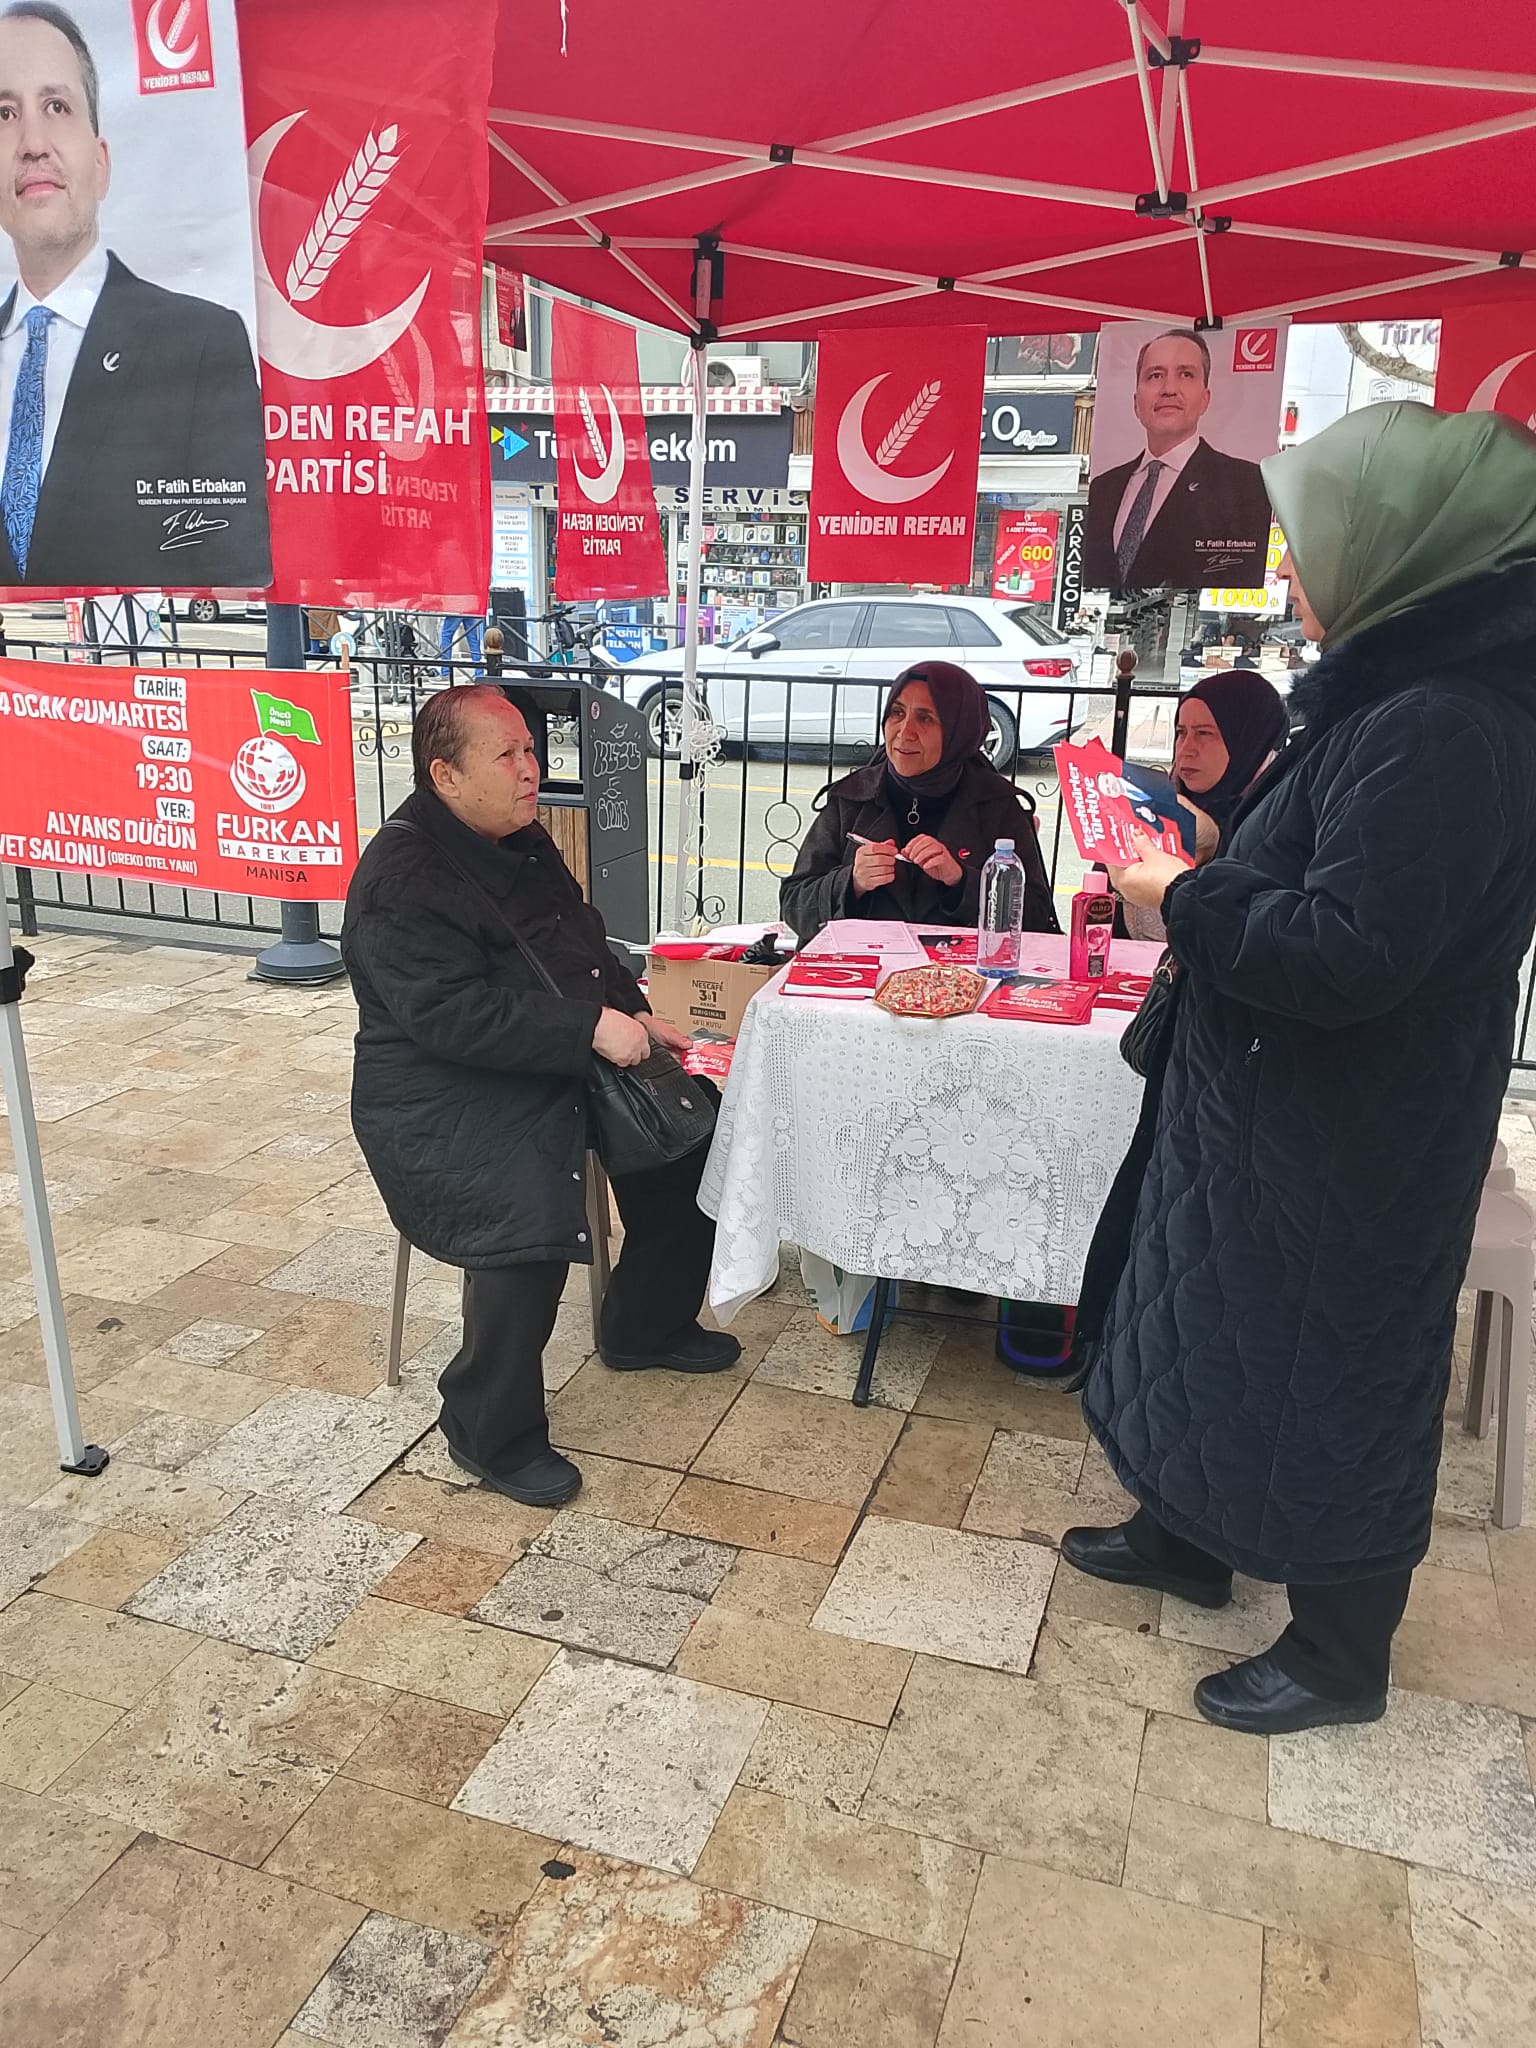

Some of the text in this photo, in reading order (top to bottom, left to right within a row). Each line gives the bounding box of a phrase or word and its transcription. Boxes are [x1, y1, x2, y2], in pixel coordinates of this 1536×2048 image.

[263, 404, 470, 445] DEN REFAH
[136, 478, 246, 494] Dr. Fatih Erbakan
[817, 510, 966, 536] YENİDEN REFAH
[1021, 545, 1053, 561] 600
[1207, 539, 1225, 548] Fatih
[1226, 539, 1257, 548] Erbakan
[1208, 588, 1268, 608] 1000
[139, 678, 183, 698] TARİH:
[13, 691, 67, 721] OCAK
[69, 698, 188, 732] CUMARTESİ
[148, 740, 187, 758] SAAT:
[136, 763, 193, 793] 19:30
[161, 801, 190, 820] YER:
[47, 811, 197, 851] ALYANS DÜĞÜN
[217, 813, 340, 845] FURKAN
[29, 834, 105, 868] SALONU
[108, 848, 144, 868] (OREKO
[144, 853, 169, 870] OTEL
[169, 858, 198, 877] YANI)
[221, 843, 339, 863] HAREKETİ
[246, 865, 308, 883] MANİSA
